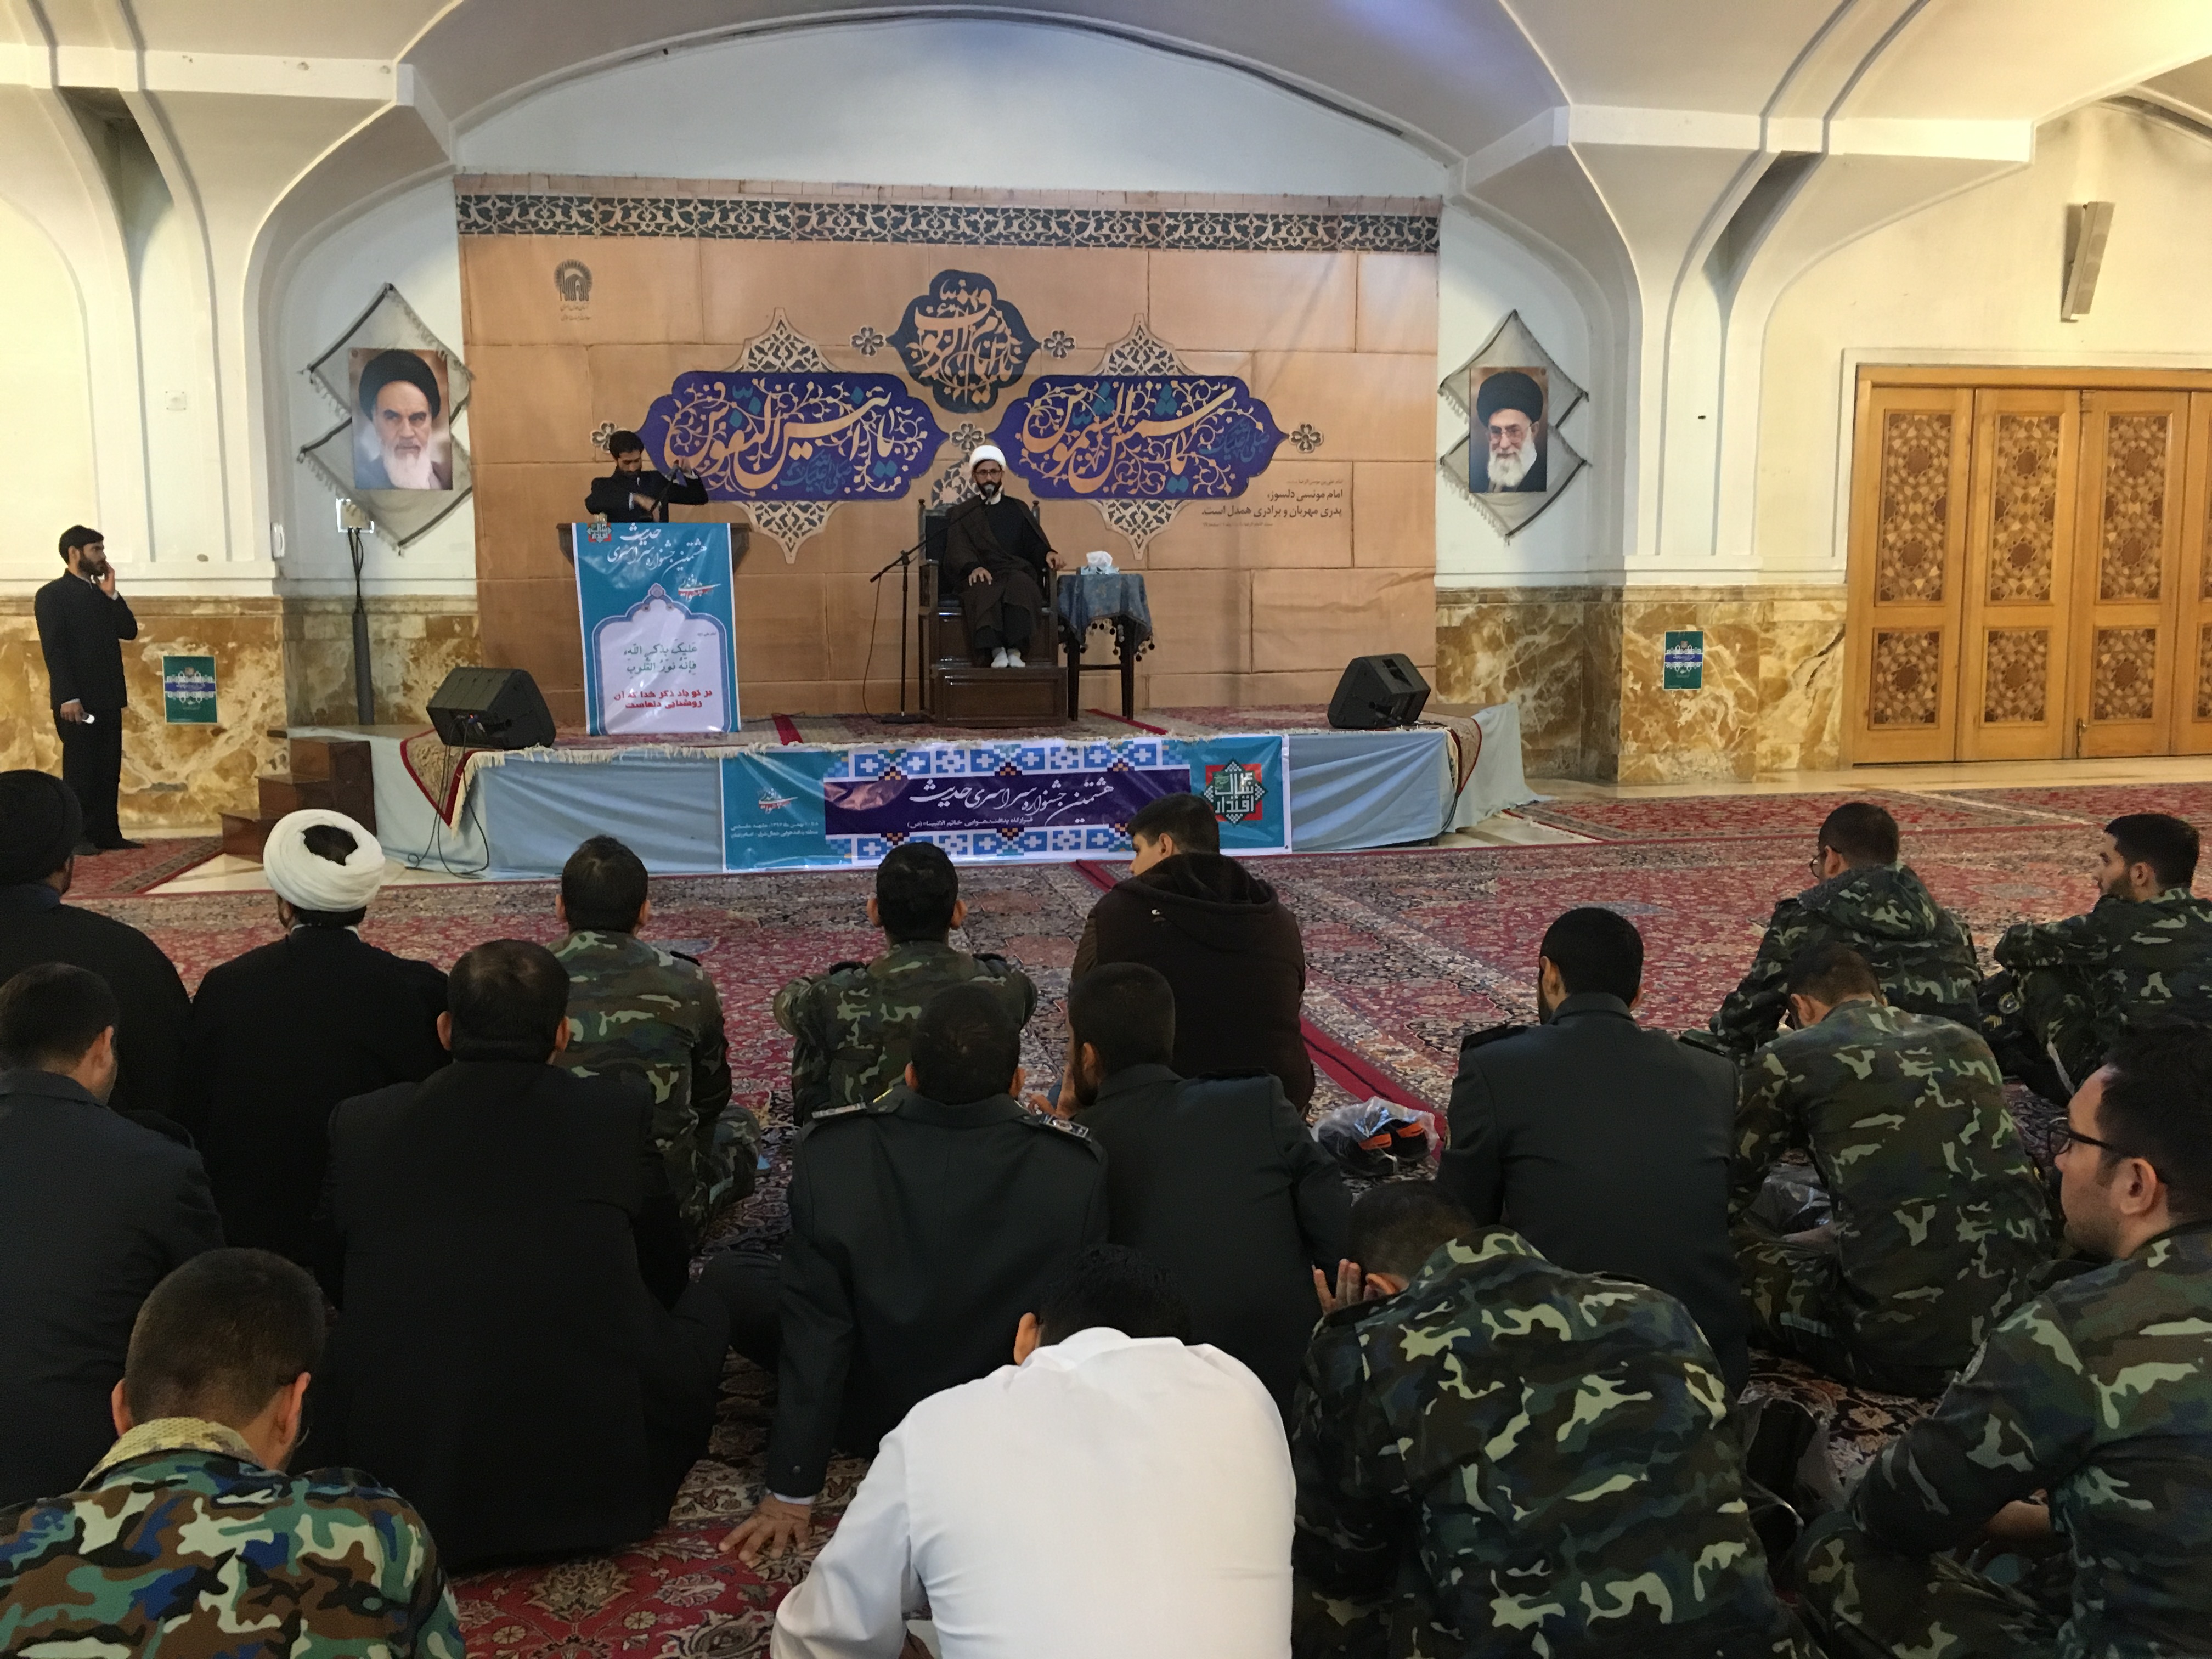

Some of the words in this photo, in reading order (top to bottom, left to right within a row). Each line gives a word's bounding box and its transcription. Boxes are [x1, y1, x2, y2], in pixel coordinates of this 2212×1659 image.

[1267, 489, 1295, 501] دلسوز،
[1327, 489, 1343, 500] امام
[1201, 505, 1226, 515] است.
[1227, 505, 1251, 517] همدل
[1253, 505, 1282, 517] برادری
[1289, 505, 1318, 517] مهربان
[1320, 507, 1342, 517] پدری
[620, 522, 662, 546] حدیث
[607, 545, 655, 564] سراسری
[645, 539, 675, 571] جشنواره
[661, 538, 707, 581] هشتمین
[613, 690, 624, 701] آن
[640, 690, 656, 698] خدا
[658, 689, 674, 699] ذکر
[677, 689, 689, 697] باد
[691, 689, 701, 698] تو
[704, 690, 713, 698] بر
[625, 699, 662, 708] دلهاست
[665, 698, 702, 709] روشنایی
[909, 778, 970, 808] حدیث
[964, 783, 1038, 809] سراسری
[1022, 779, 1068, 815] جشنواره
[1044, 777, 1114, 826] هشتمین
[1215, 794, 1254, 813] اقتدار
[1010, 816, 1033, 825] قرارگاه
